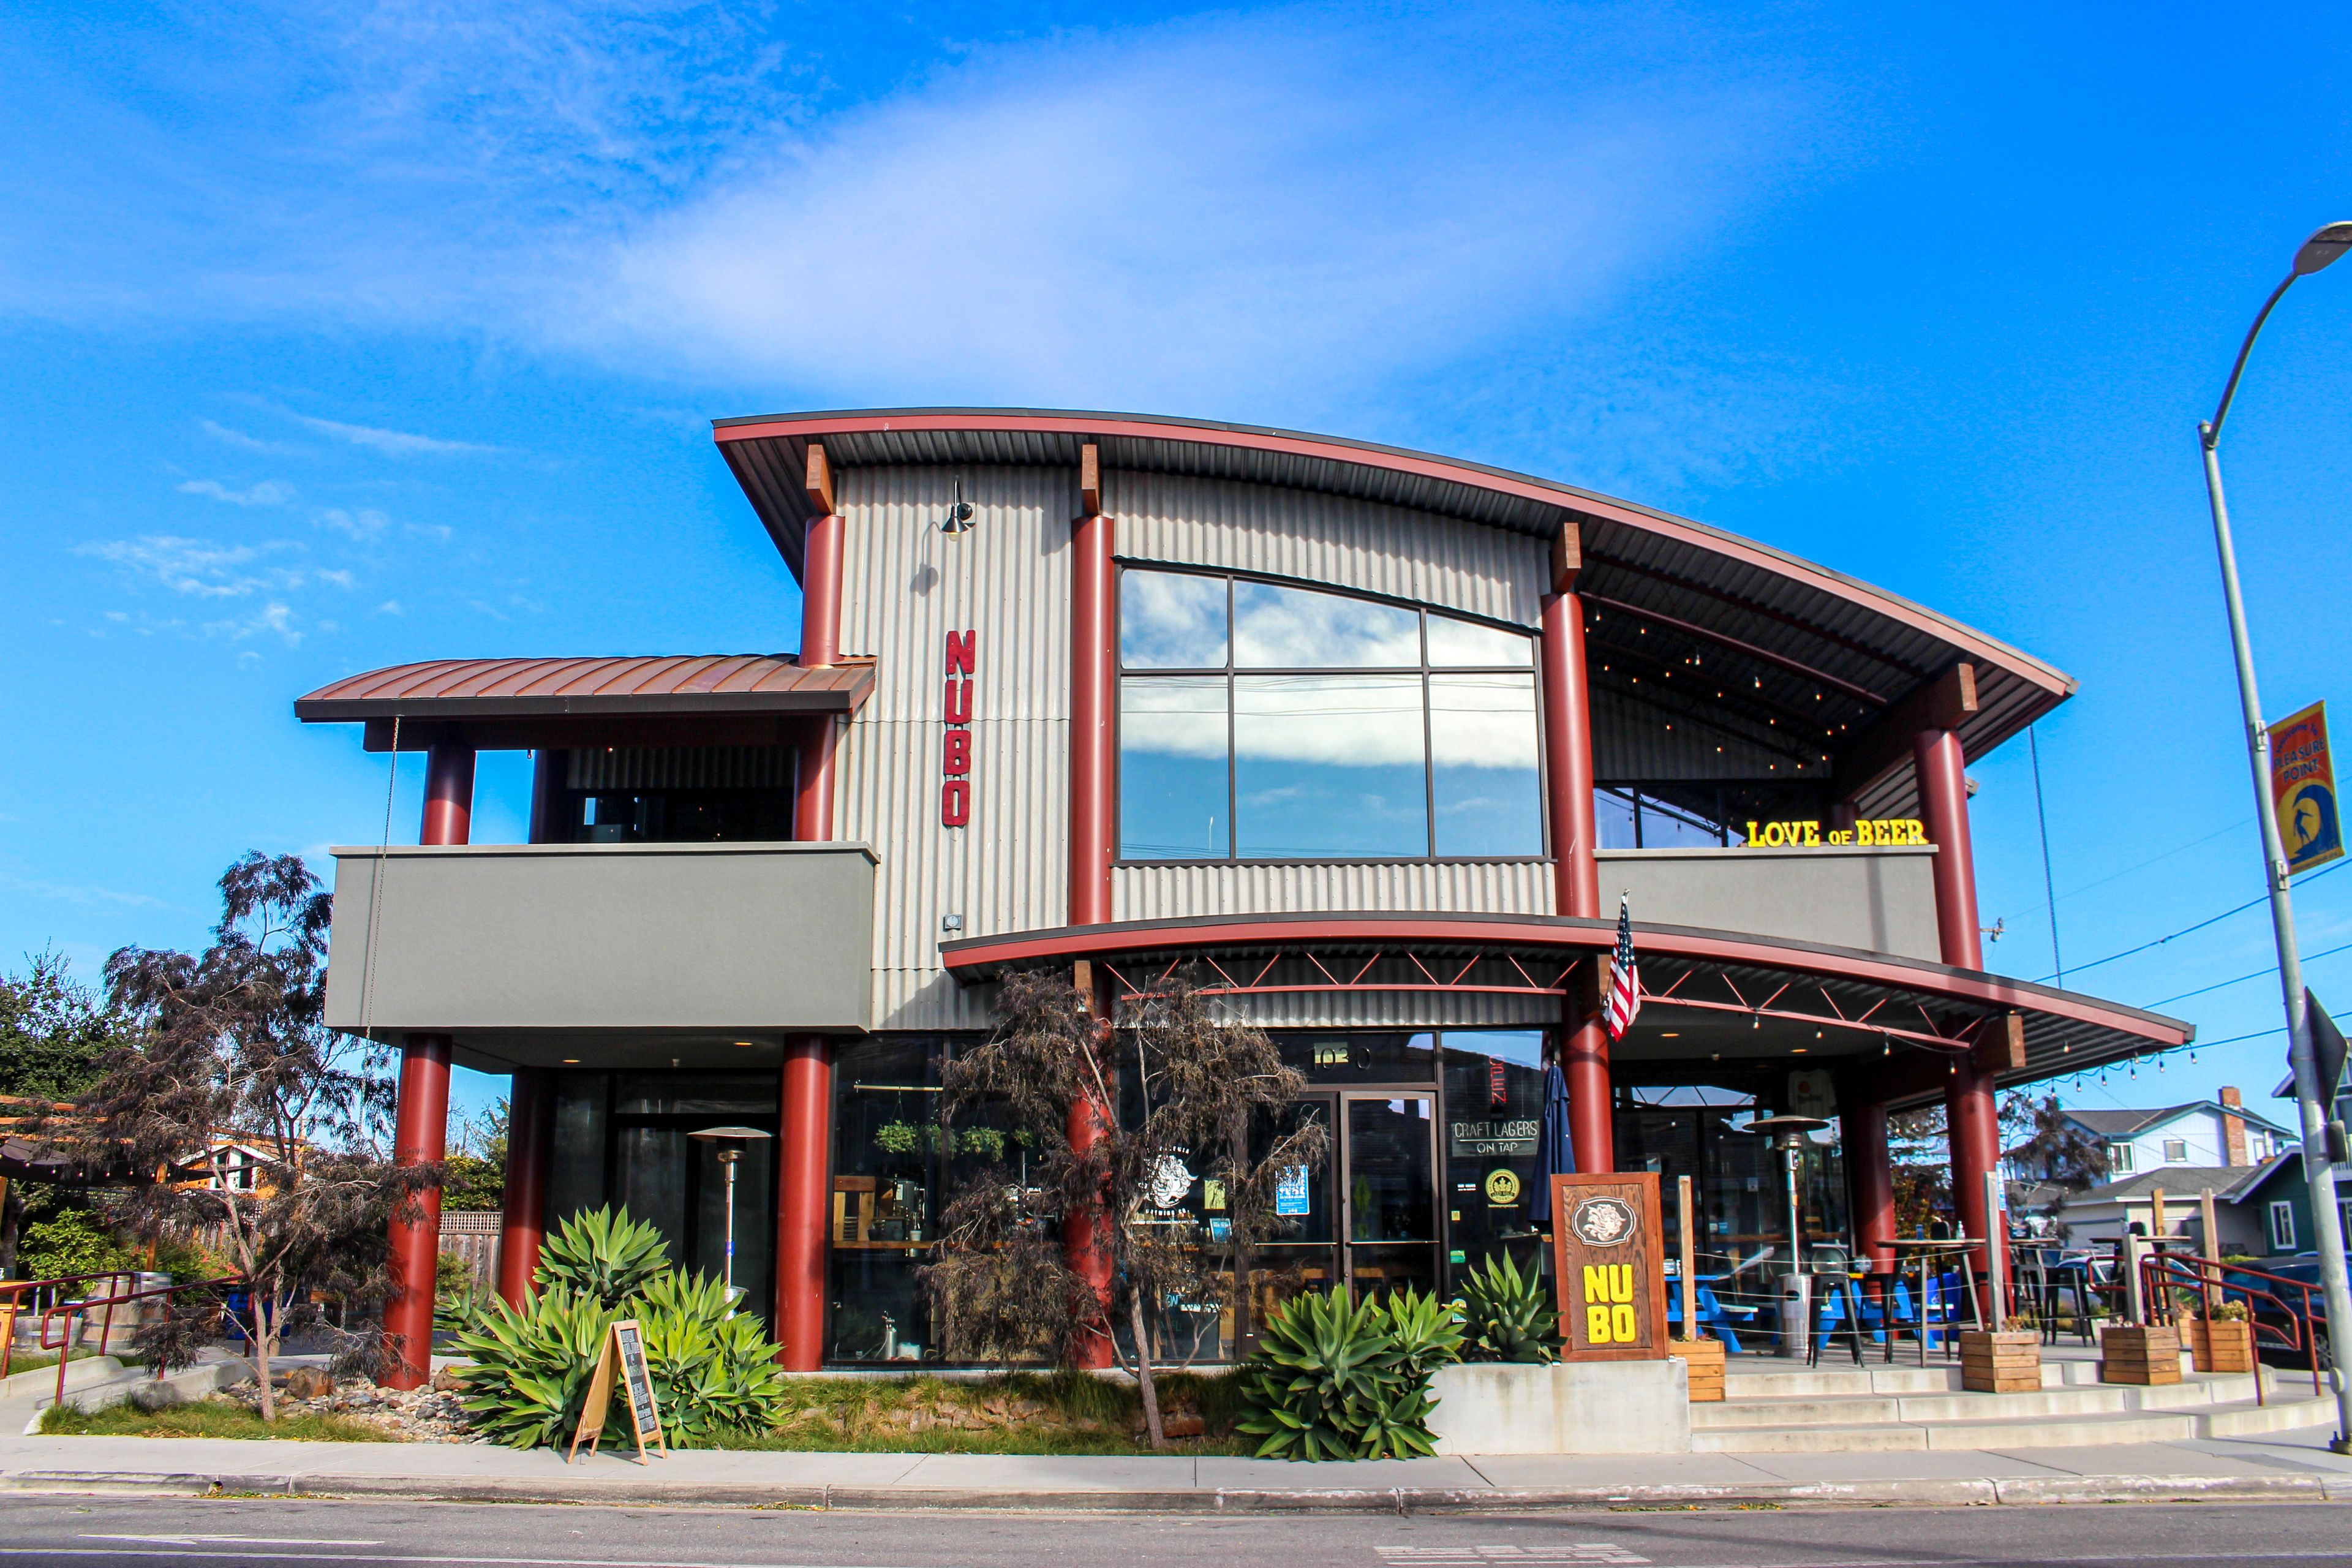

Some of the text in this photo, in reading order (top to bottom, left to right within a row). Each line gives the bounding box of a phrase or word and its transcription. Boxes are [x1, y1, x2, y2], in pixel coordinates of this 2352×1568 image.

[942, 630, 976, 827] NUBO
[2274, 736, 2326, 771] PLEASURE
[2283, 758, 2319, 785] POINT
[1746, 820, 1821, 847] LOVE
[1855, 818, 1930, 846] BEER
[1304, 1046, 1371, 1071] 1030
[1489, 1054, 1507, 1104] OPEN
[1454, 1121, 1538, 1138] CRAFT LAGERS
[1477, 1142, 1518, 1153] ON TAP
[1583, 1264, 1634, 1303] NU
[1586, 1304, 1636, 1344] BO
